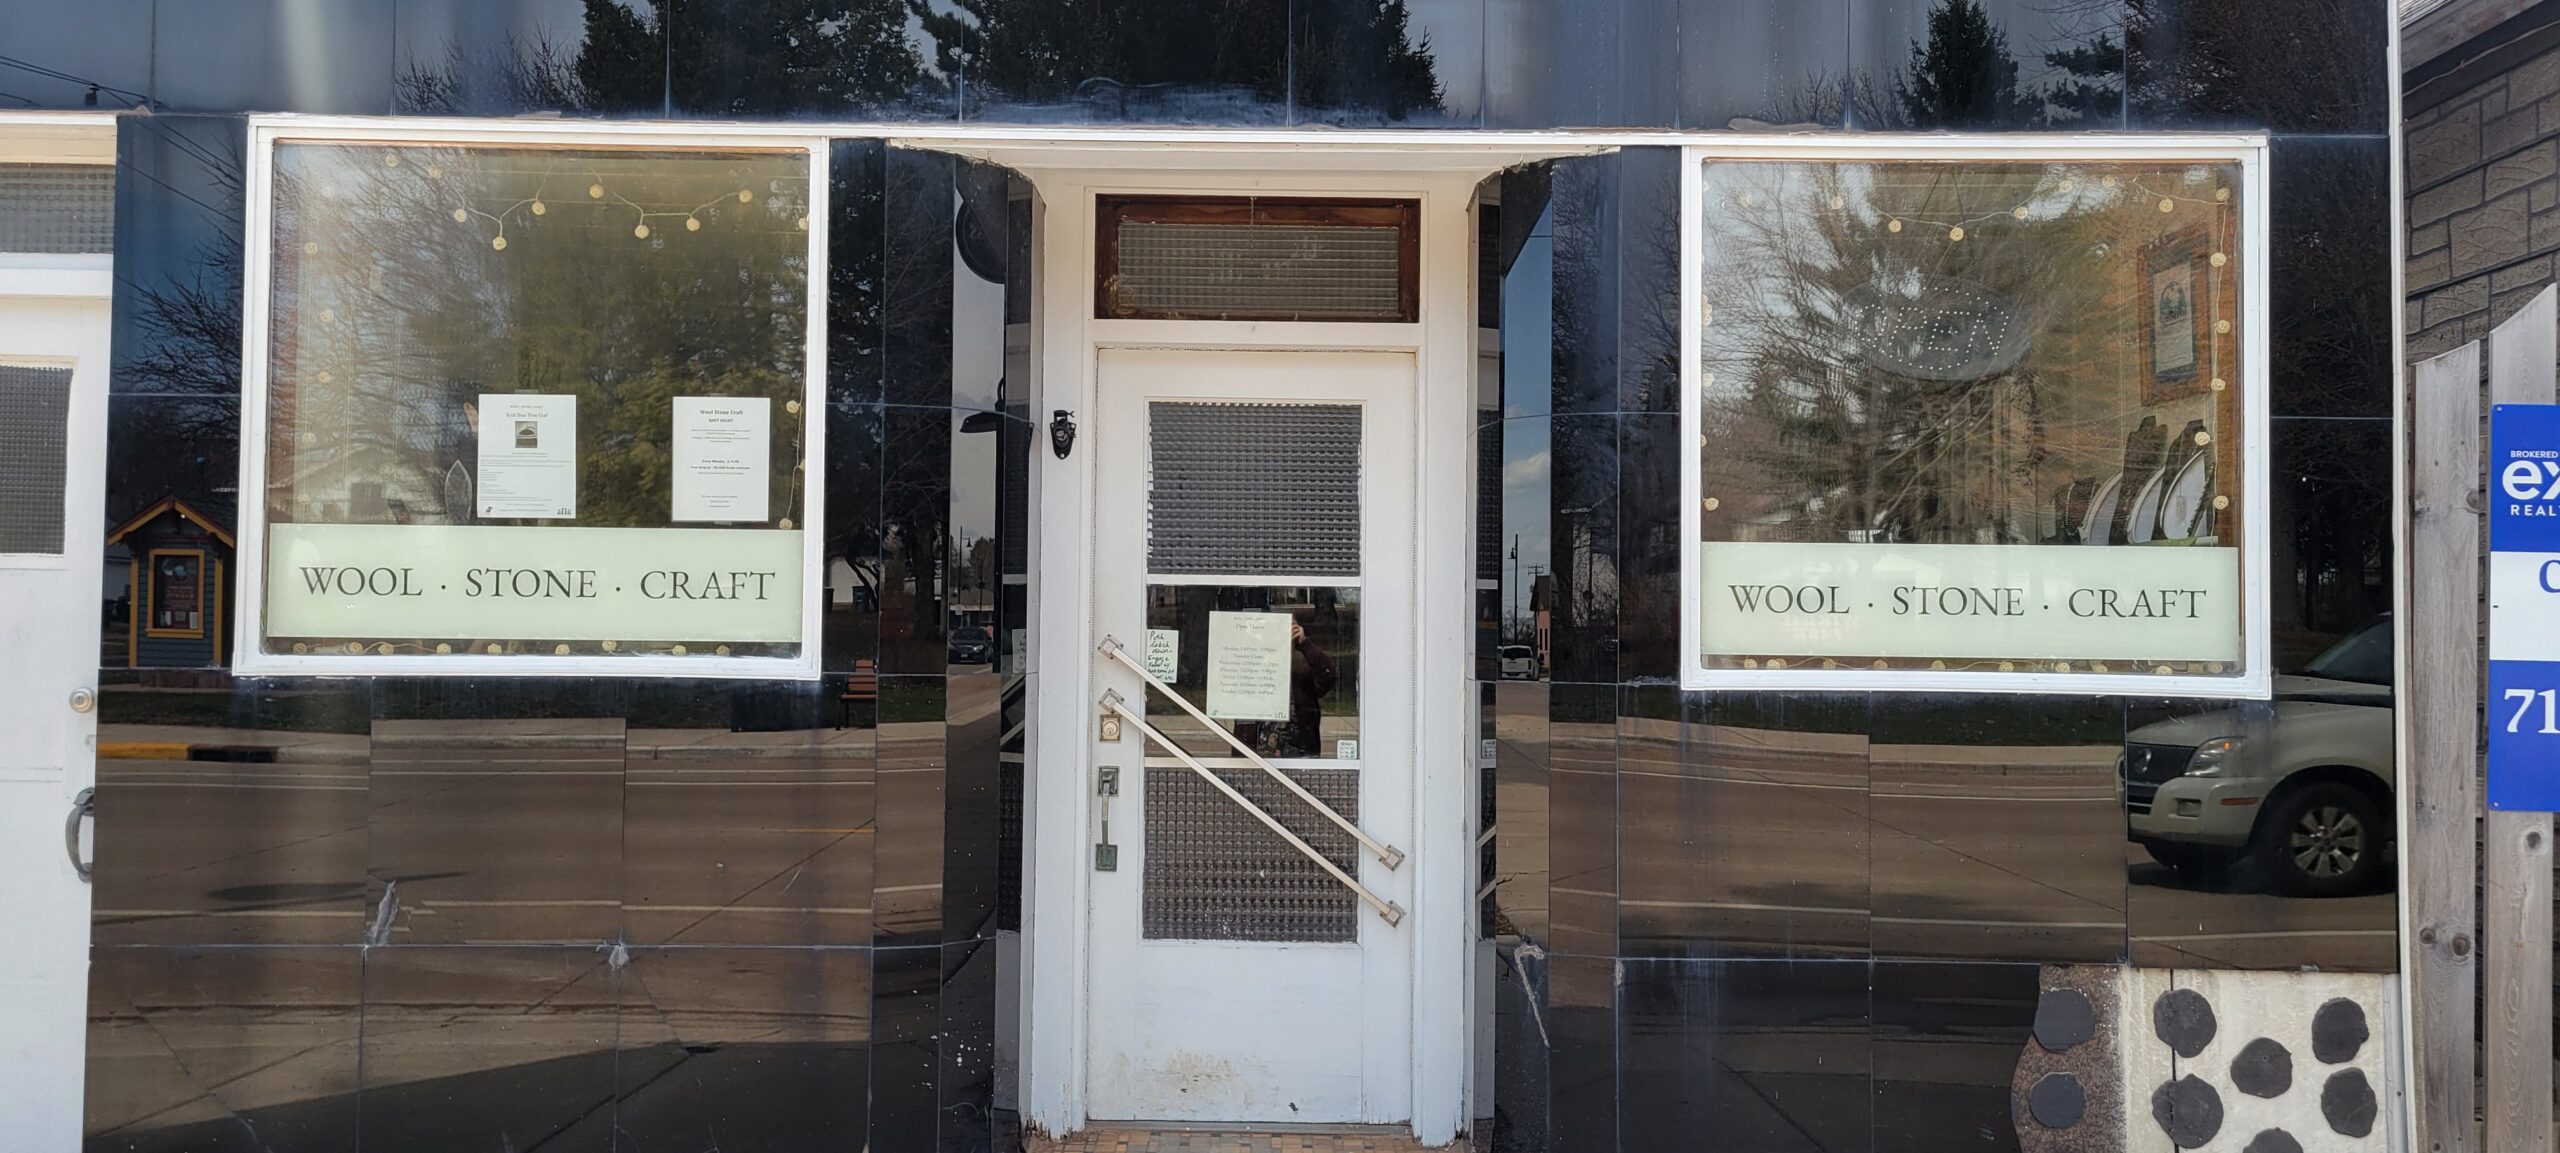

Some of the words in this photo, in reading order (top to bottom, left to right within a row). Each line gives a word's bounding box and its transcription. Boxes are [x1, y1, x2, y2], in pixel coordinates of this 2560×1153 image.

[2510, 450, 2558, 458] BROKERED
[2510, 504, 2560, 516] REAL
[299, 566, 423, 596] WOOL
[466, 568, 597, 598] STONE
[640, 570, 776, 600] CRAFT
[1728, 585, 1850, 614] WOOL
[1892, 586, 2024, 616] STONE
[2068, 588, 2207, 618] CRAFT
[2504, 688, 2560, 733] 71
